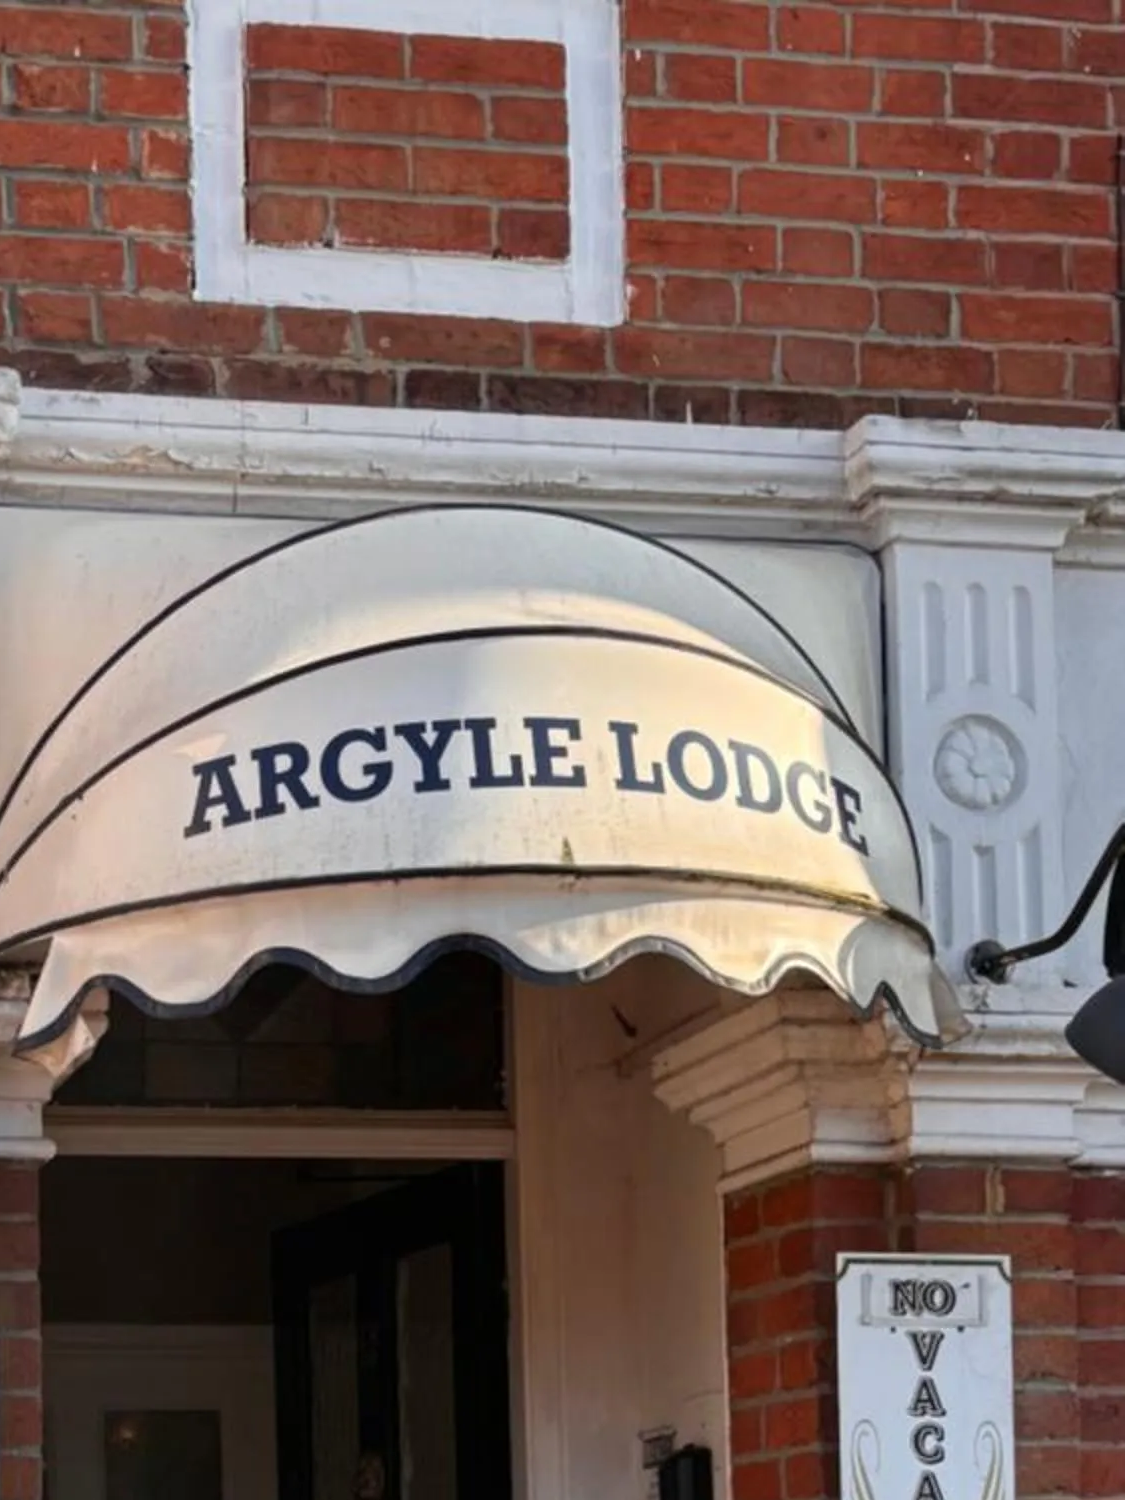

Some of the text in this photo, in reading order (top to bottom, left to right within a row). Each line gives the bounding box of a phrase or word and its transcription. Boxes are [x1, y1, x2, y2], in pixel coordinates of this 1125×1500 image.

[183, 717, 870, 857] ARGYLE LODGE
[888, 1278, 958, 1318] NO
